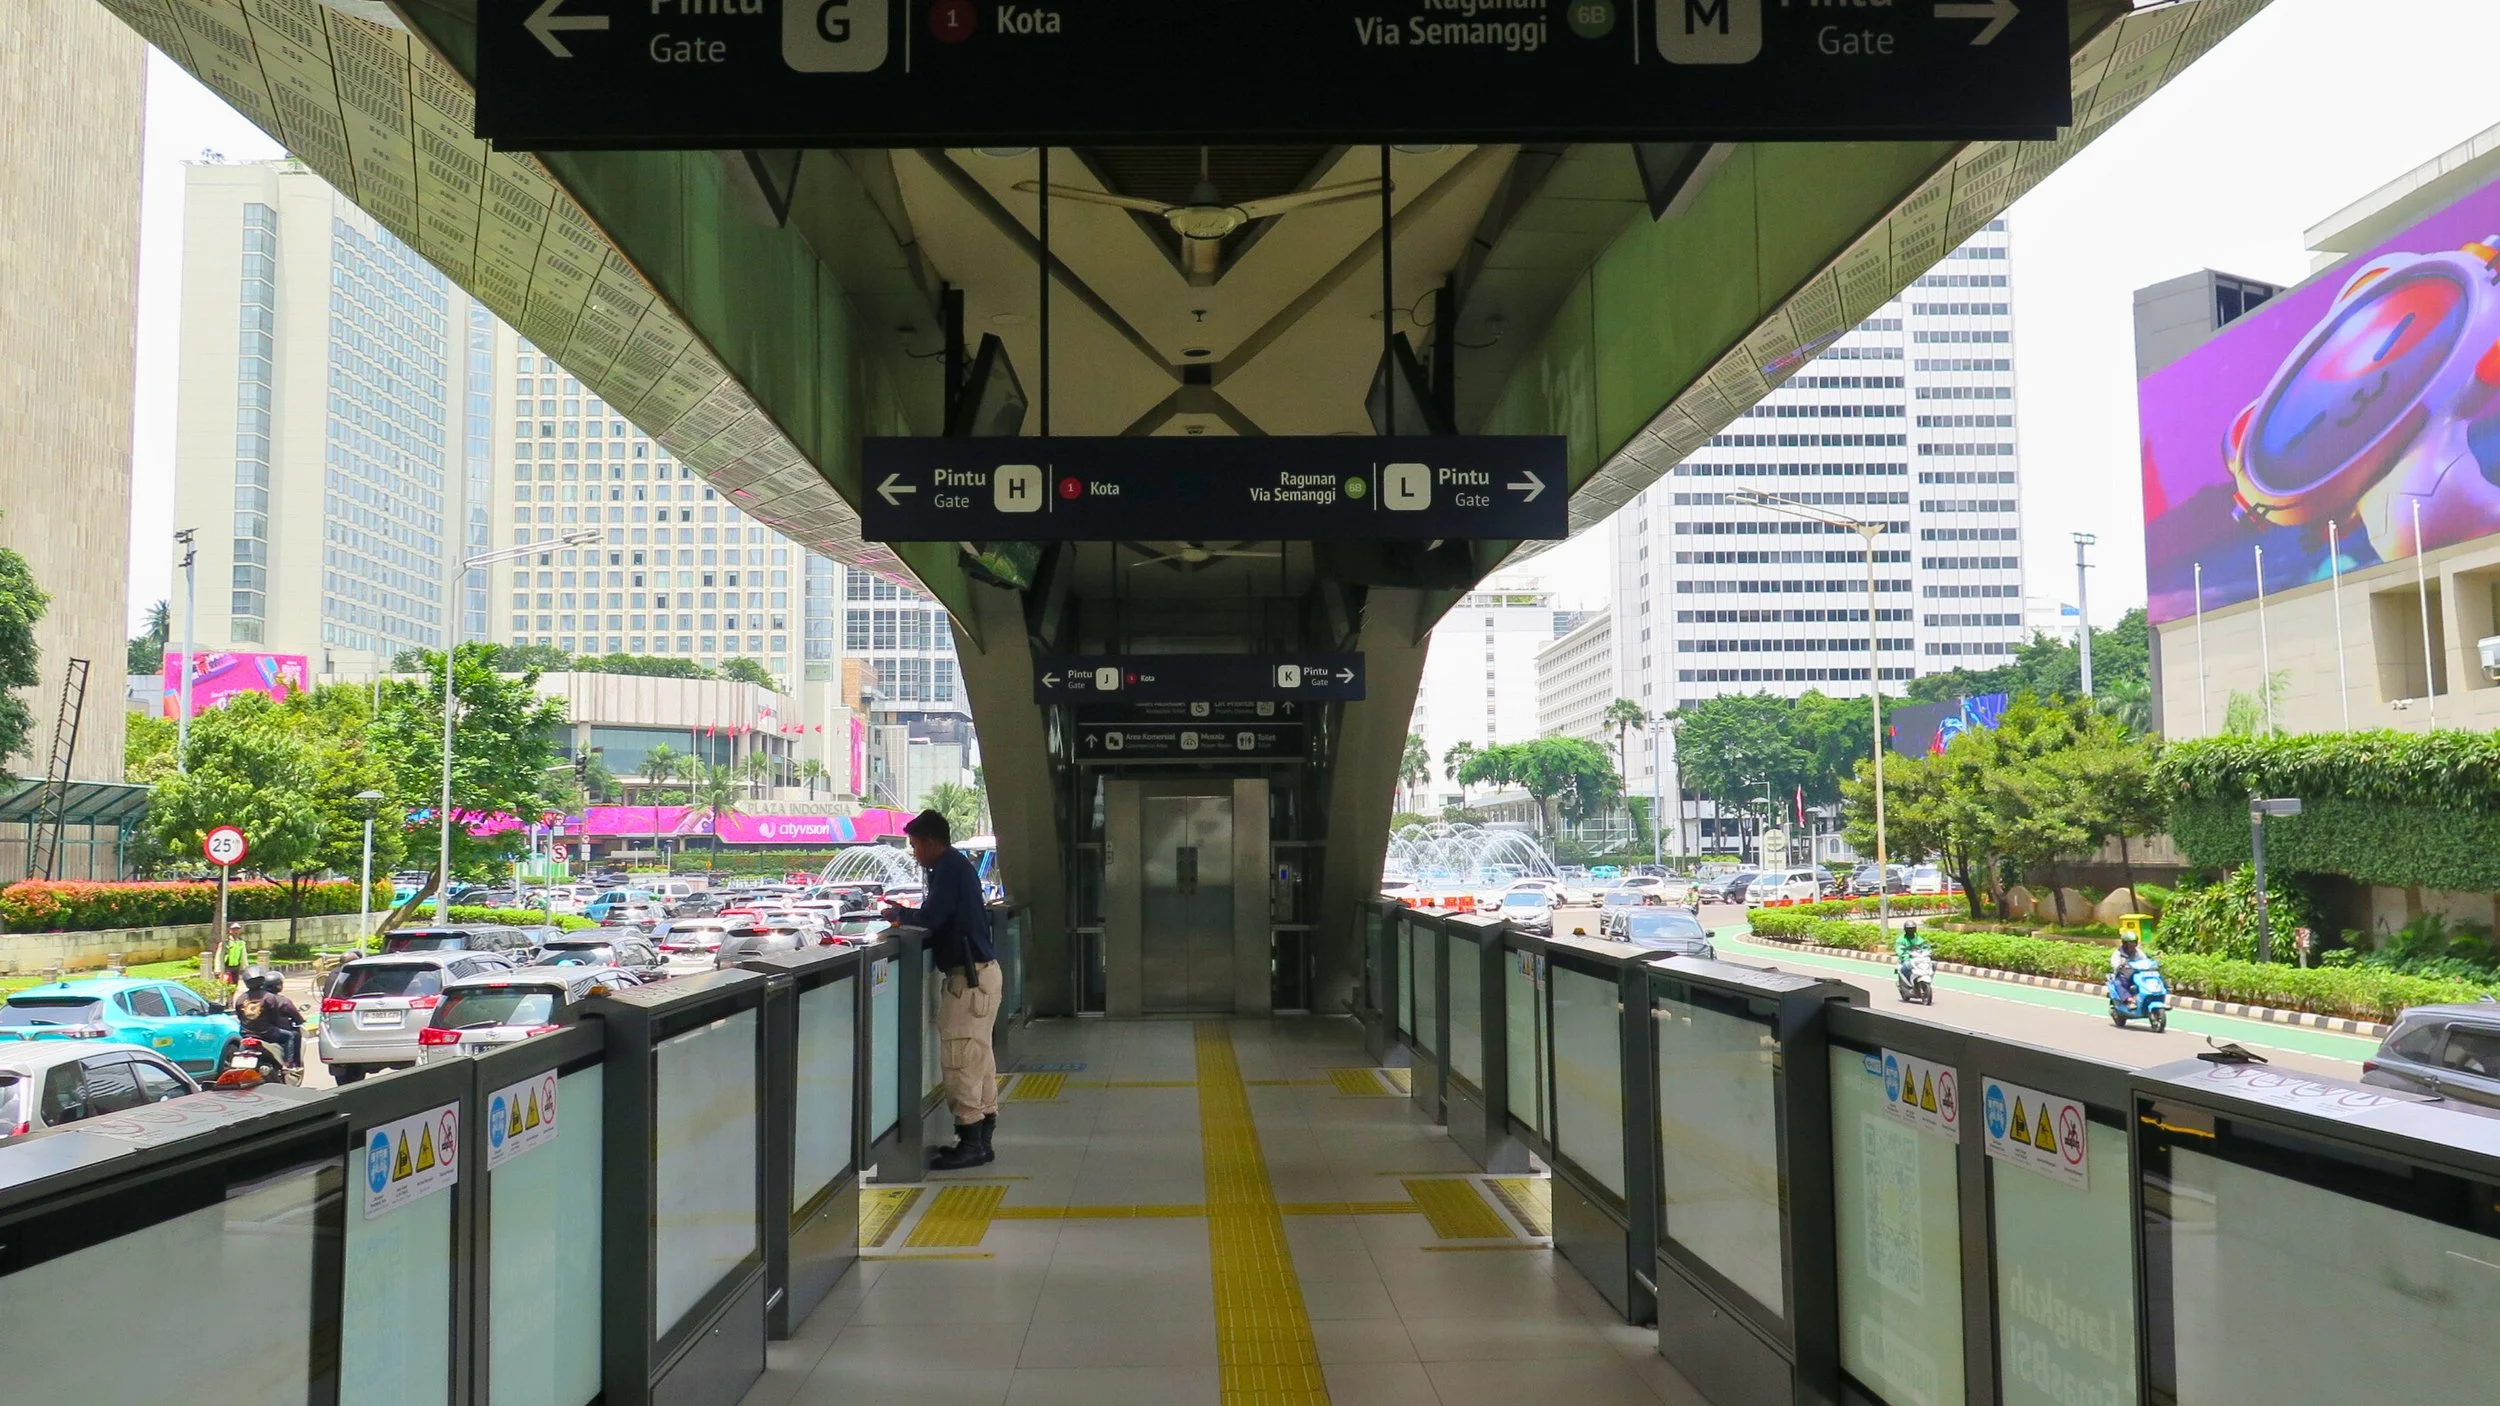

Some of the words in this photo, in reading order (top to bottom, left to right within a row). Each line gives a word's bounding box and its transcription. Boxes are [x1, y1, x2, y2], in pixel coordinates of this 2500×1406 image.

[815, 0, 850, 43] G
[947, 9, 958, 27] 1
[997, 5, 1062, 34] Kota
[1577, 5, 1606, 24] 6B
[1684, 0, 1729, 34] M
[1354, 16, 1401, 45] Via
[1409, 12, 1547, 51] Semanggi
[1818, 25, 1895, 55] Gate
[650, 33, 727, 63] Gate
[934, 468, 986, 486] Pintu
[1280, 471, 1336, 488] Ragunan
[1438, 467, 1490, 485] Pintu
[1009, 478, 1026, 499] H
[1067, 483, 1074, 493] 1
[1090, 481, 1120, 495] Kota
[1250, 487, 1271, 501] Via
[1274, 487, 1336, 505] Semanggi
[1400, 477, 1415, 498] L
[934, 494, 970, 508] Gate
[1455, 492, 1490, 507] Gate
[1068, 669, 1093, 679] Pintu
[1104, 673, 1109, 684] J
[1285, 671, 1293, 682] K
[1303, 666, 1329, 676] Pintu
[1068, 681, 1085, 689] Gate
[1311, 678, 1329, 687] Gate
[748, 803, 785, 815] PLAZA
[790, 803, 851, 815] INDONESIA
[779, 822, 830, 838] cityvision
[213, 838, 232, 852] 25
